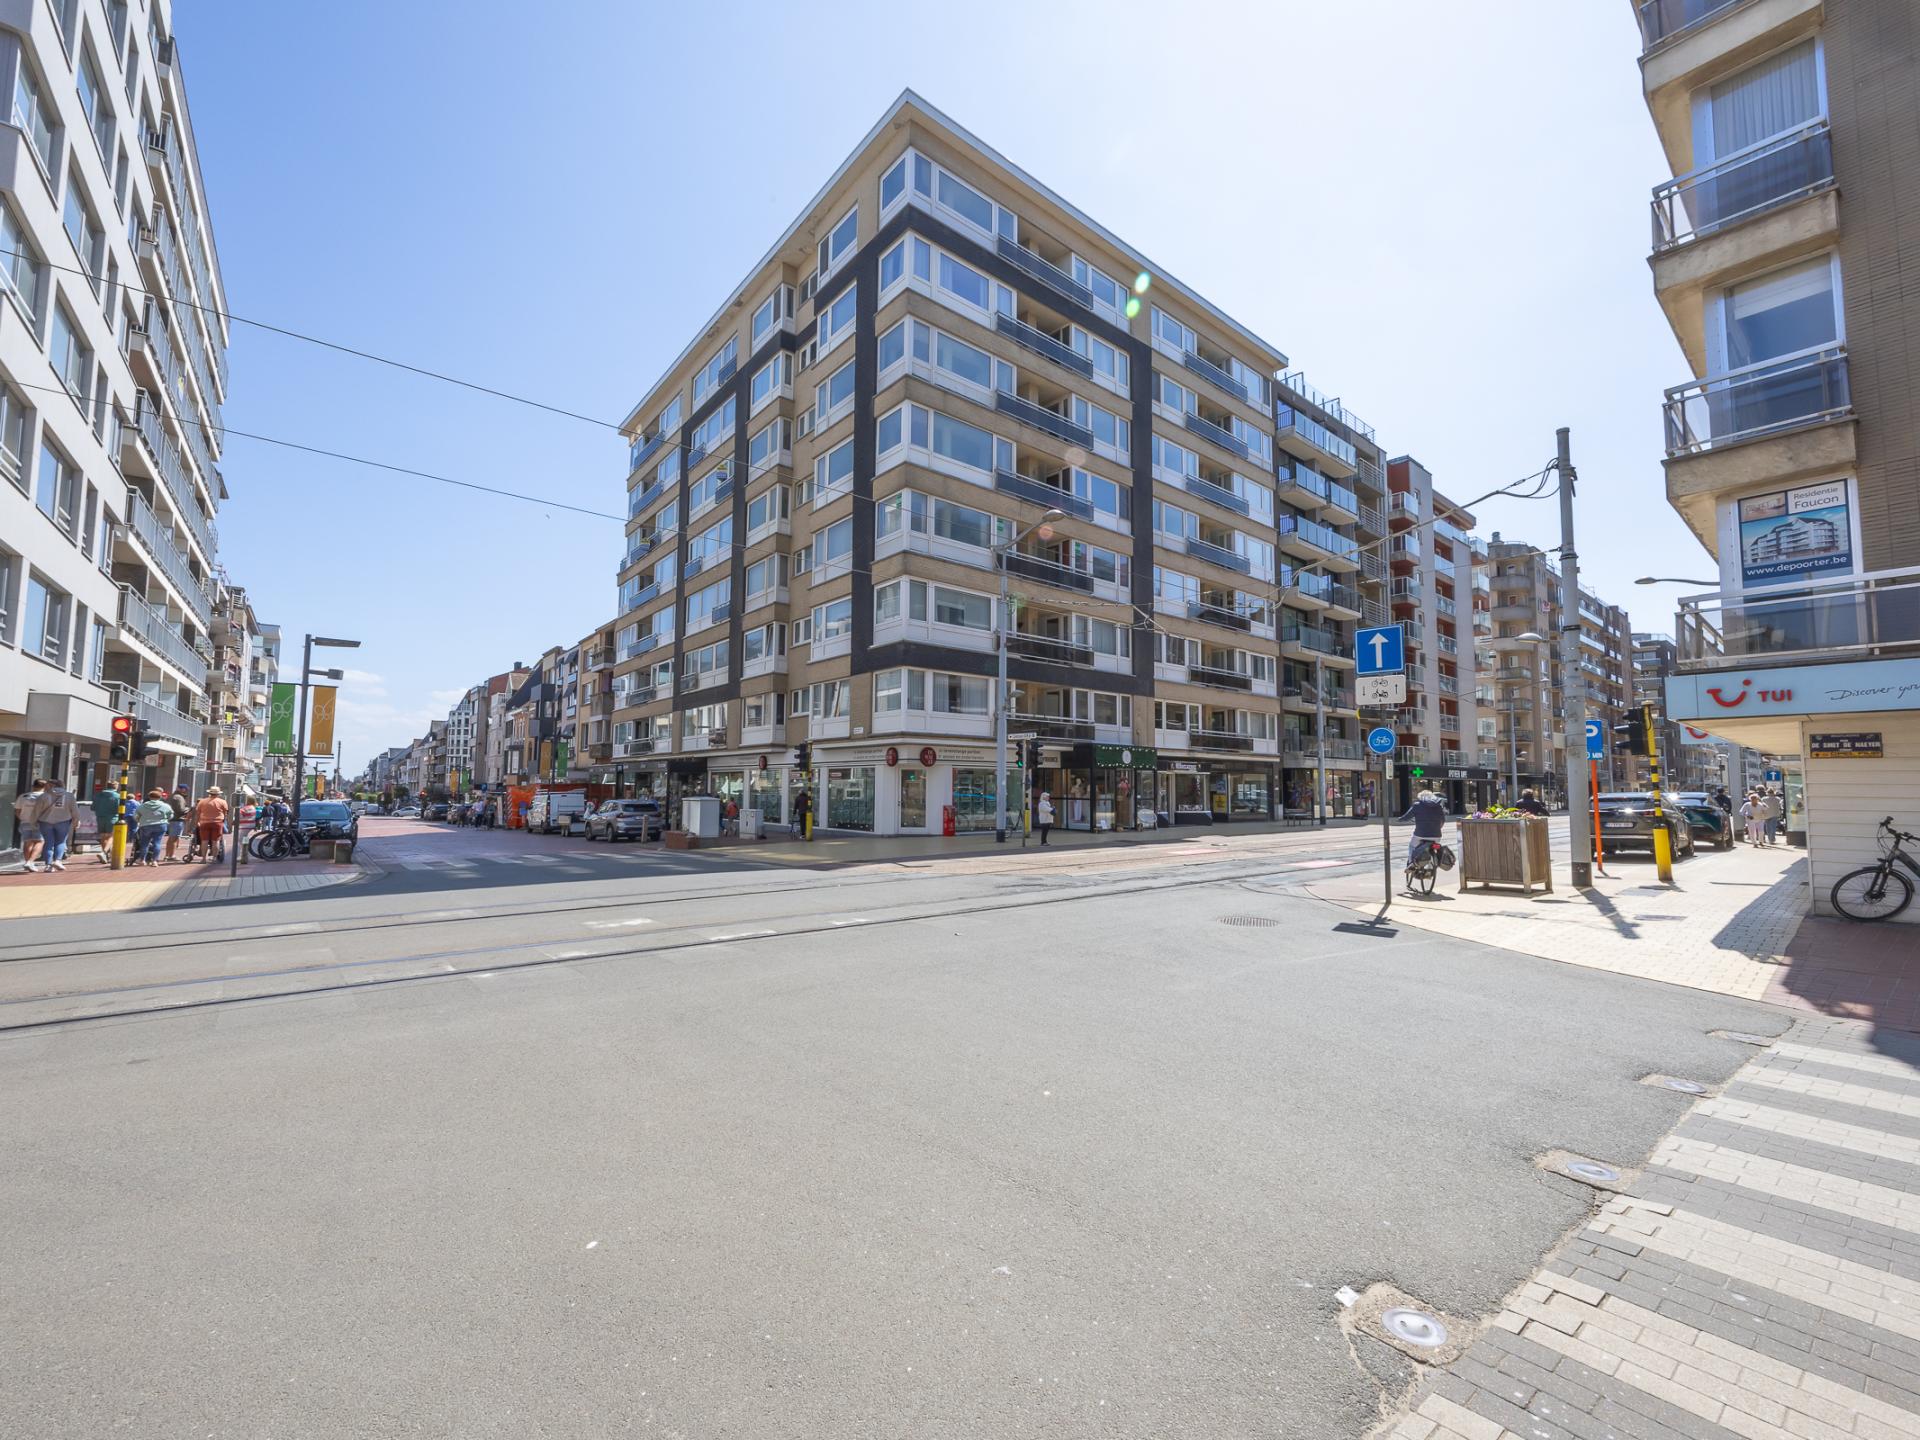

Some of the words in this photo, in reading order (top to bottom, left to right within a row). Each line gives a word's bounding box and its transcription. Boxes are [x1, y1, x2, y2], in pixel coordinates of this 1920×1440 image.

[1793, 487, 1839, 500] Residentie
[1794, 495, 1839, 509] Faucon
[1746, 556, 1848, 575] www.depoorter.be
[1757, 689, 1793, 702] TUI
[1825, 685, 1896, 701] Discover
